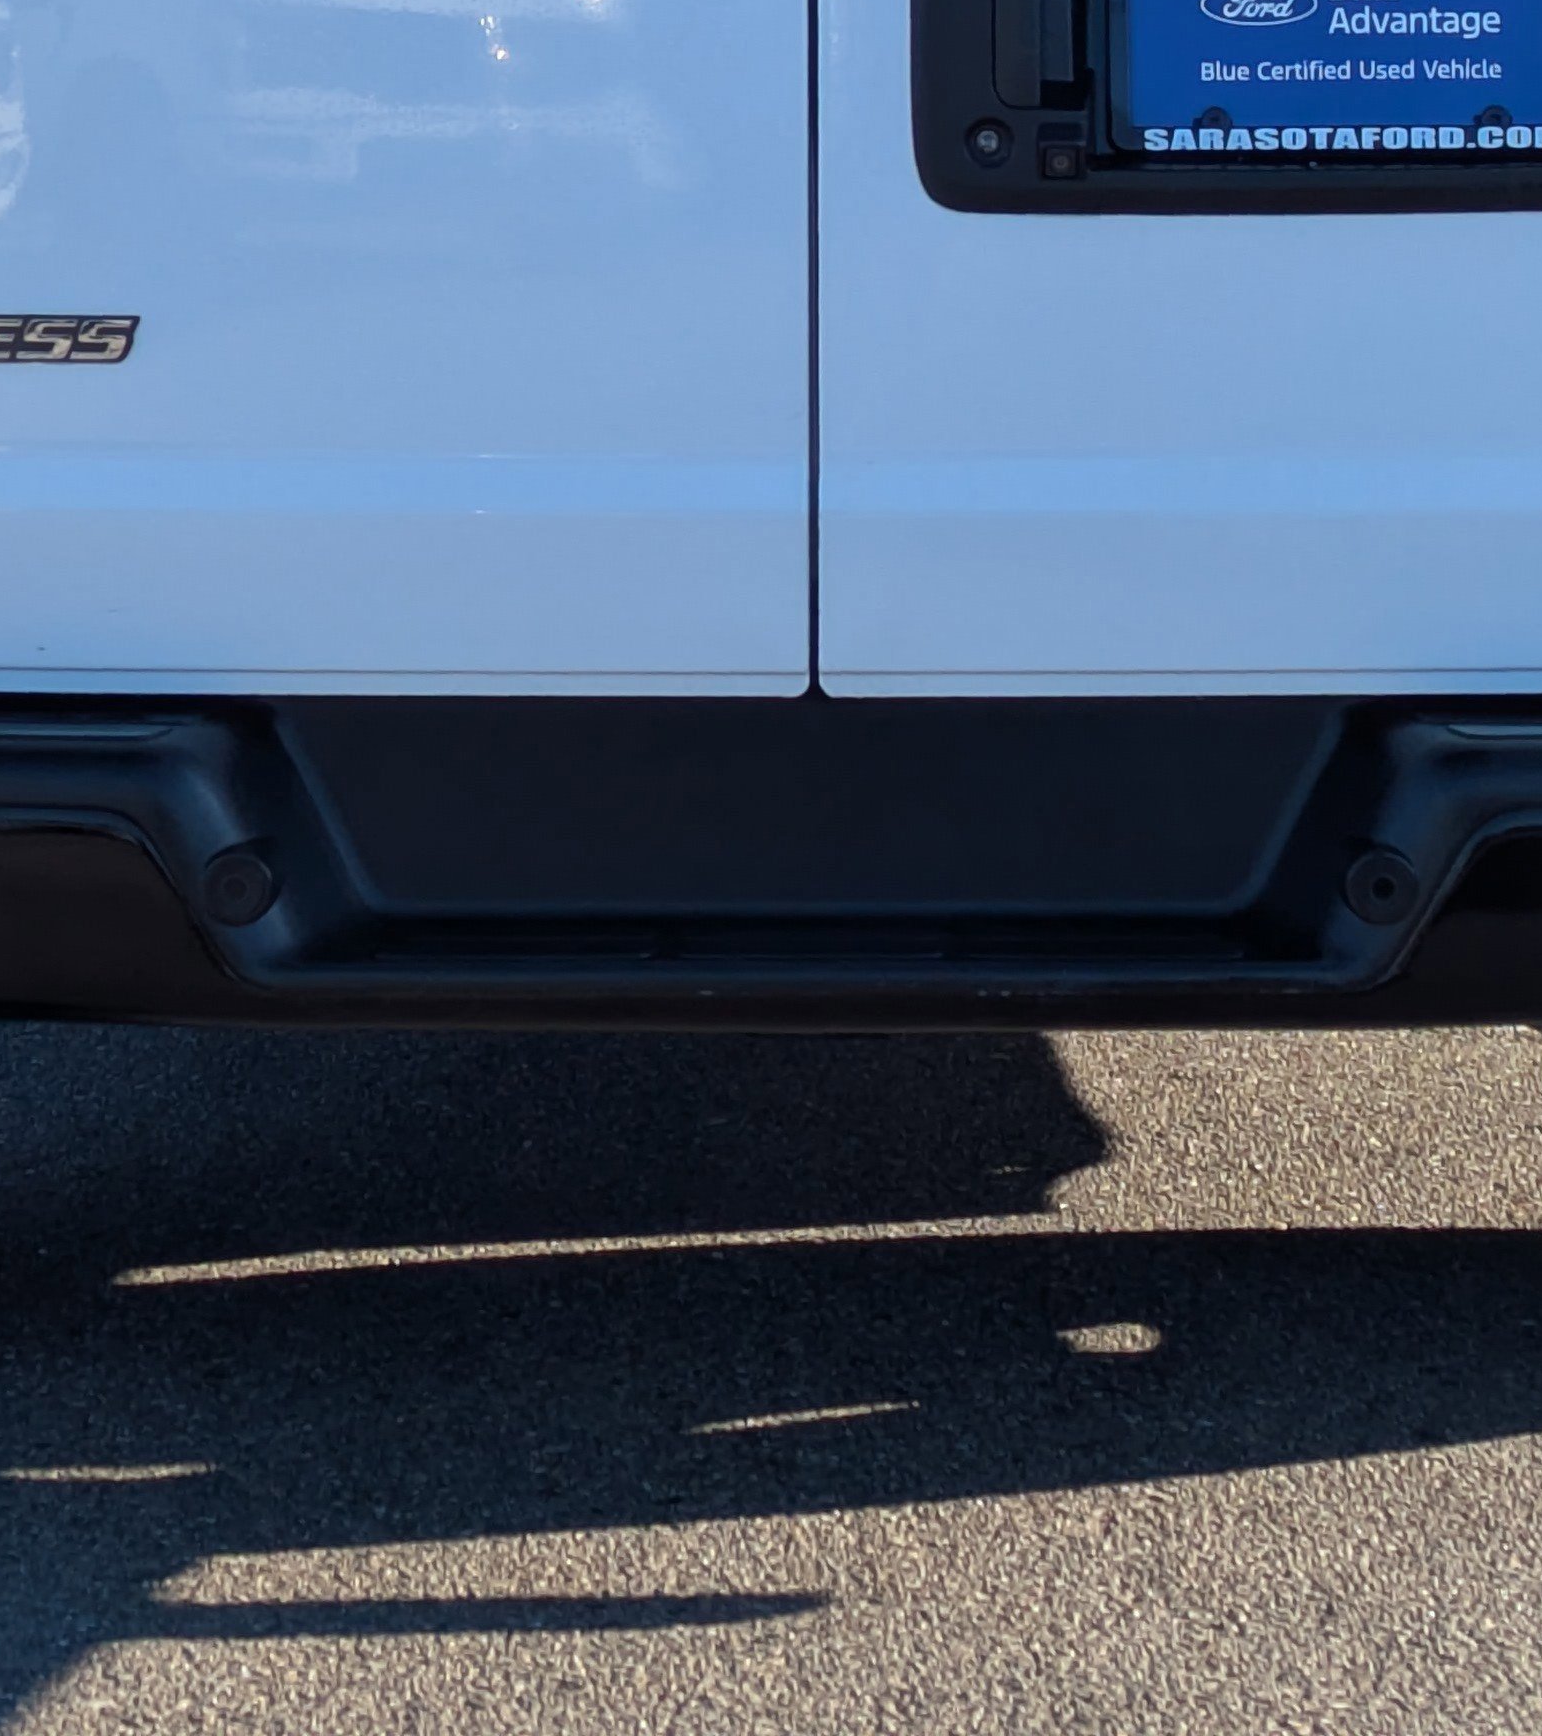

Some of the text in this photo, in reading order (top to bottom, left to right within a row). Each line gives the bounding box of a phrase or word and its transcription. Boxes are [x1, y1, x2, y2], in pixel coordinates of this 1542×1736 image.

[1328, 6, 1502, 39] Advantage
[1201, 59, 1503, 81] Blue Certified Used Vehicle
